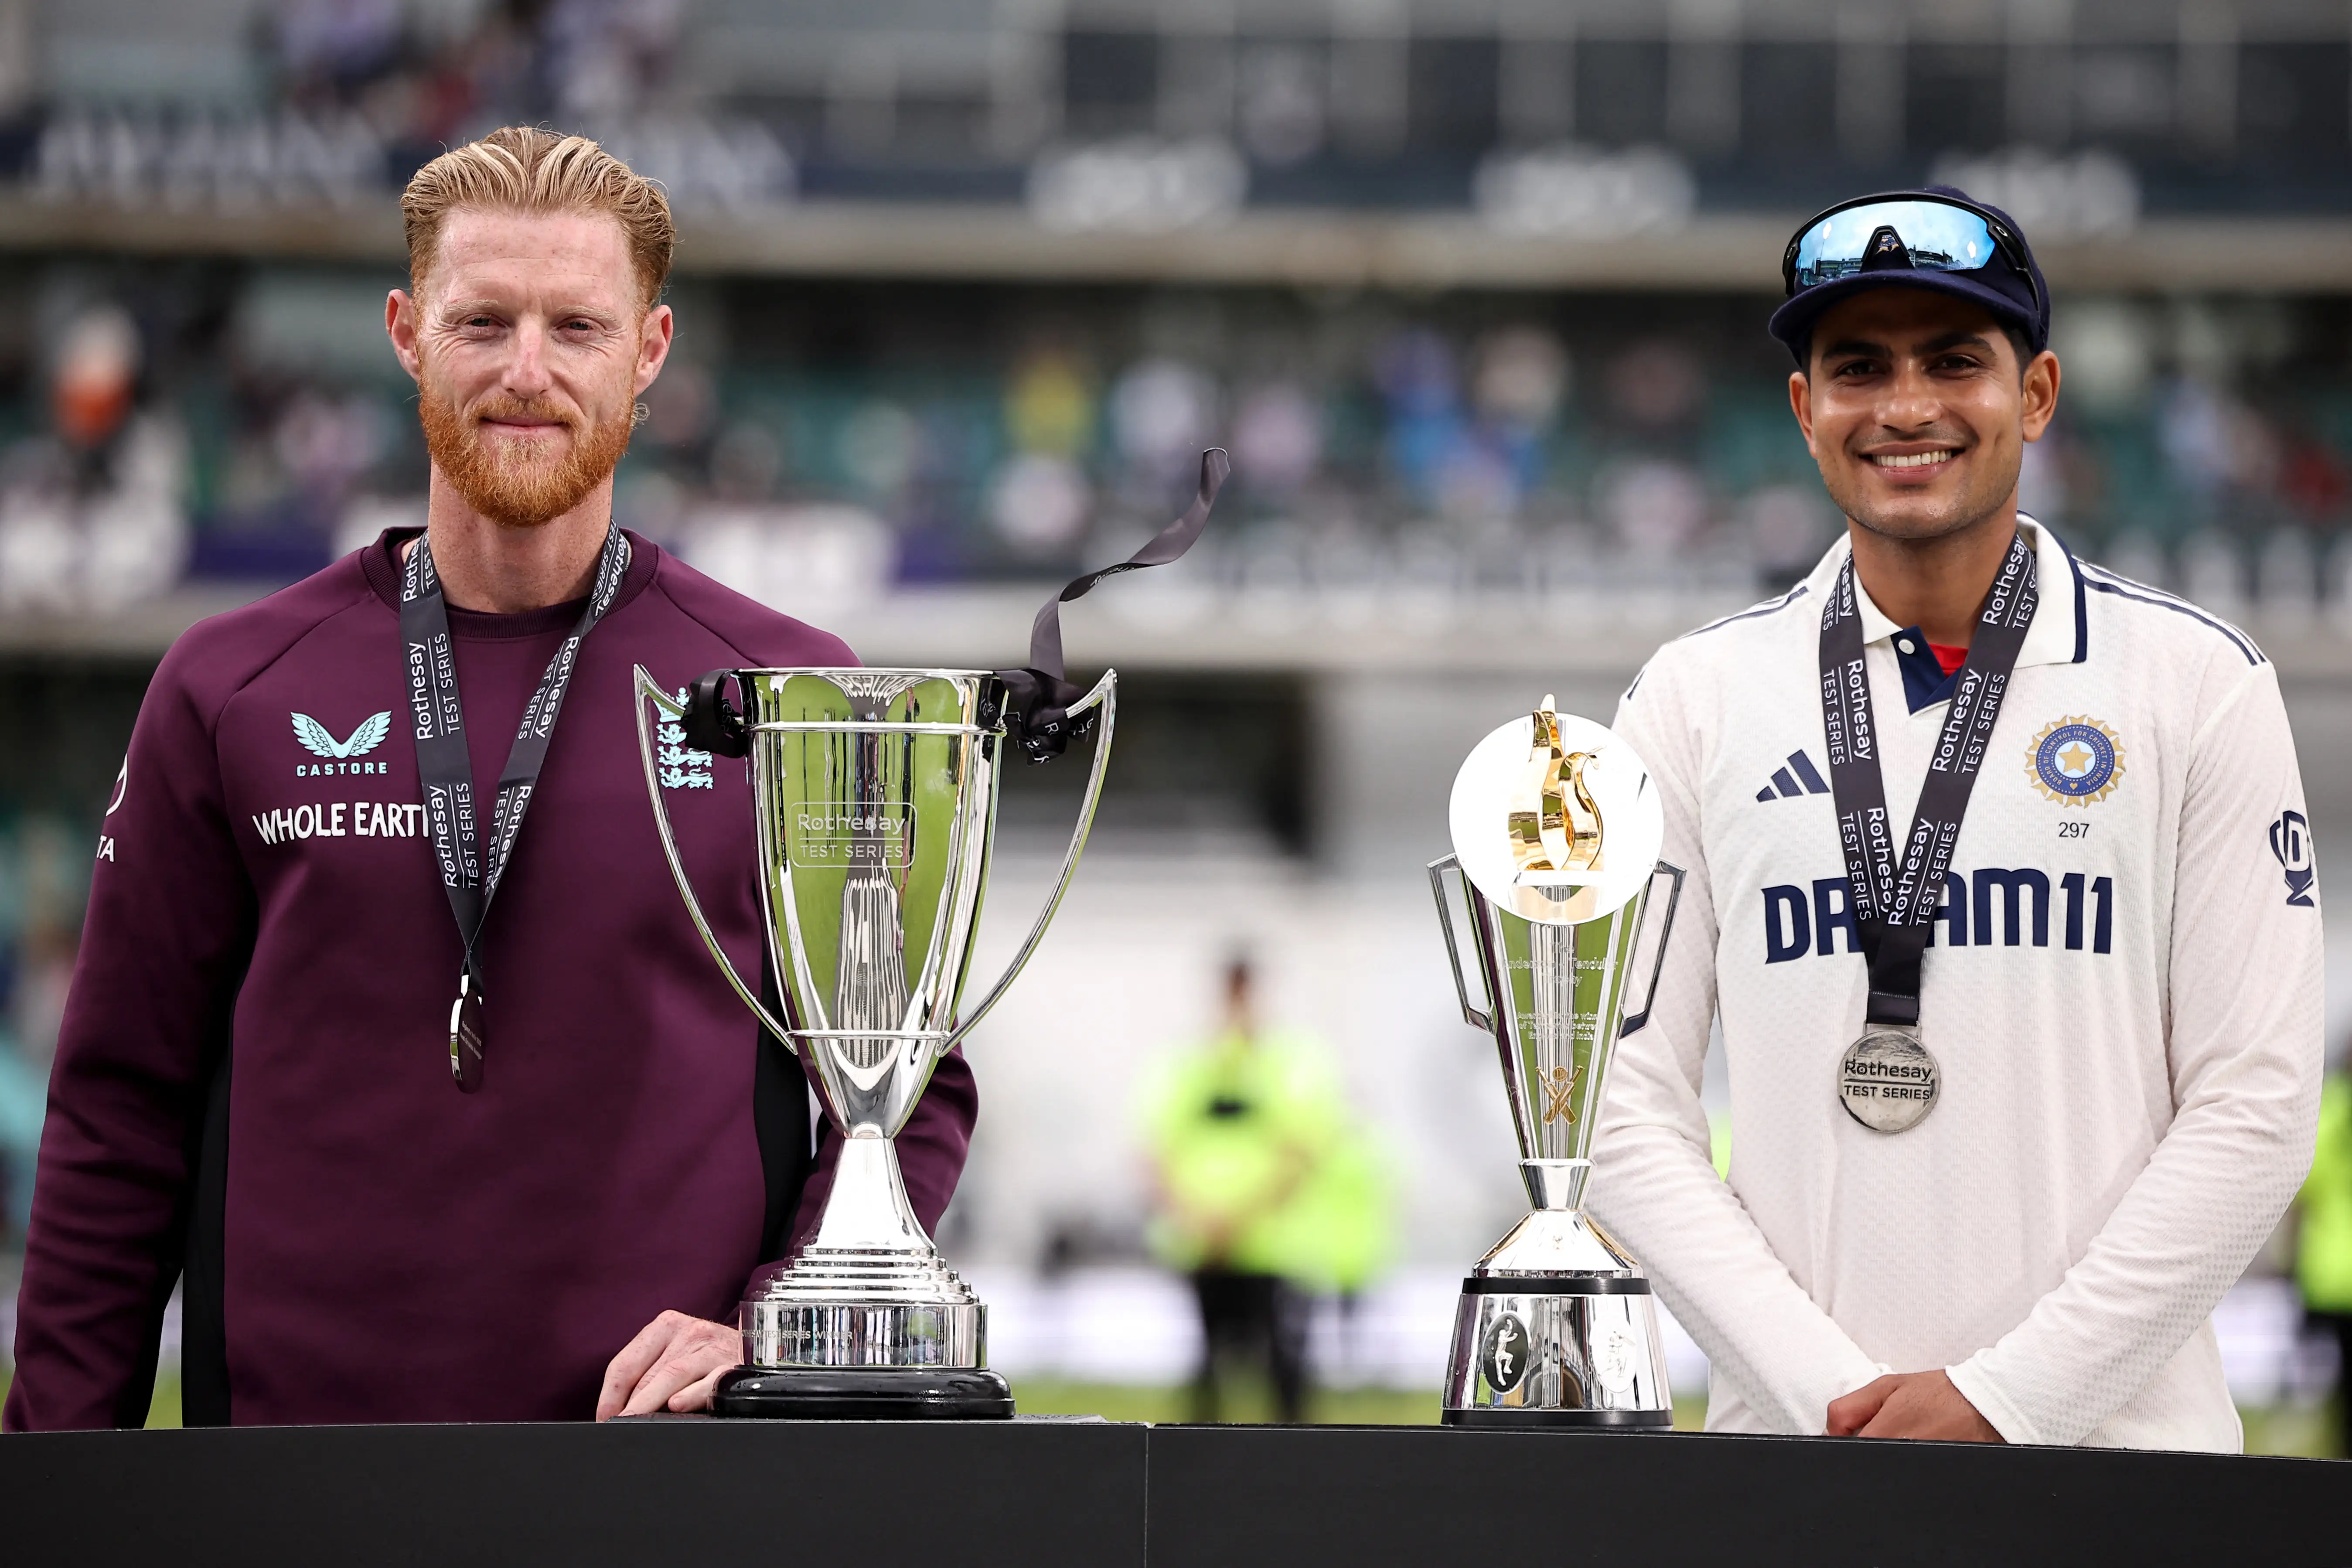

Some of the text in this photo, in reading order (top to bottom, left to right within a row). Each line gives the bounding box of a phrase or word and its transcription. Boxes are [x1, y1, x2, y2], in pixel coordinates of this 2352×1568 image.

[607, 519, 617, 552] TEST
[403, 535, 422, 602] Rothe
[424, 552, 435, 590] TEST
[595, 534, 627, 617] Rothesay
[1982, 534, 2028, 625] Rothesay
[2012, 593, 2035, 628] TEST
[409, 642, 434, 740] Rothesay
[435, 633, 460, 734] TEST SERIES
[535, 636, 579, 739] Rothesay
[1848, 659, 1872, 760] Rothesay
[518, 687, 545, 740] SERIES
[1823, 669, 1845, 765] TEST SERIES
[1932, 668, 1982, 772] Rothesay
[1961, 674, 2006, 774] TEST SERIES
[297, 762, 388, 777] CASTORE
[2045, 732, 2071, 754] CONTROL
[2089, 734, 2107, 759] CRICKET
[2100, 761, 2107, 769] IN
[2045, 766, 2062, 785] BOARD
[2086, 770, 2103, 786] INDIA
[252, 802, 347, 845] WHOLE
[493, 787, 509, 828] TEST
[798, 813, 906, 835] Rothesay
[2059, 822, 2090, 839] 297
[429, 786, 458, 888] Rothesay
[456, 782, 479, 889] TEST SERIES
[491, 786, 532, 889] Rothesay
[800, 845, 903, 859] TEST SERIES
[1841, 812, 1871, 920] TEST SERIES
[1888, 818, 1934, 926] Rothesay
[1916, 822, 1957, 926] TEST SERIES
[1760, 868, 2112, 965] DRAM11
[1844, 1059, 1932, 1082] Rothesay
[1844, 1085, 1930, 1100] TEST SERIES
[782, 1330, 811, 1339] SERIES
[813, 1331, 853, 1340] WINNER
